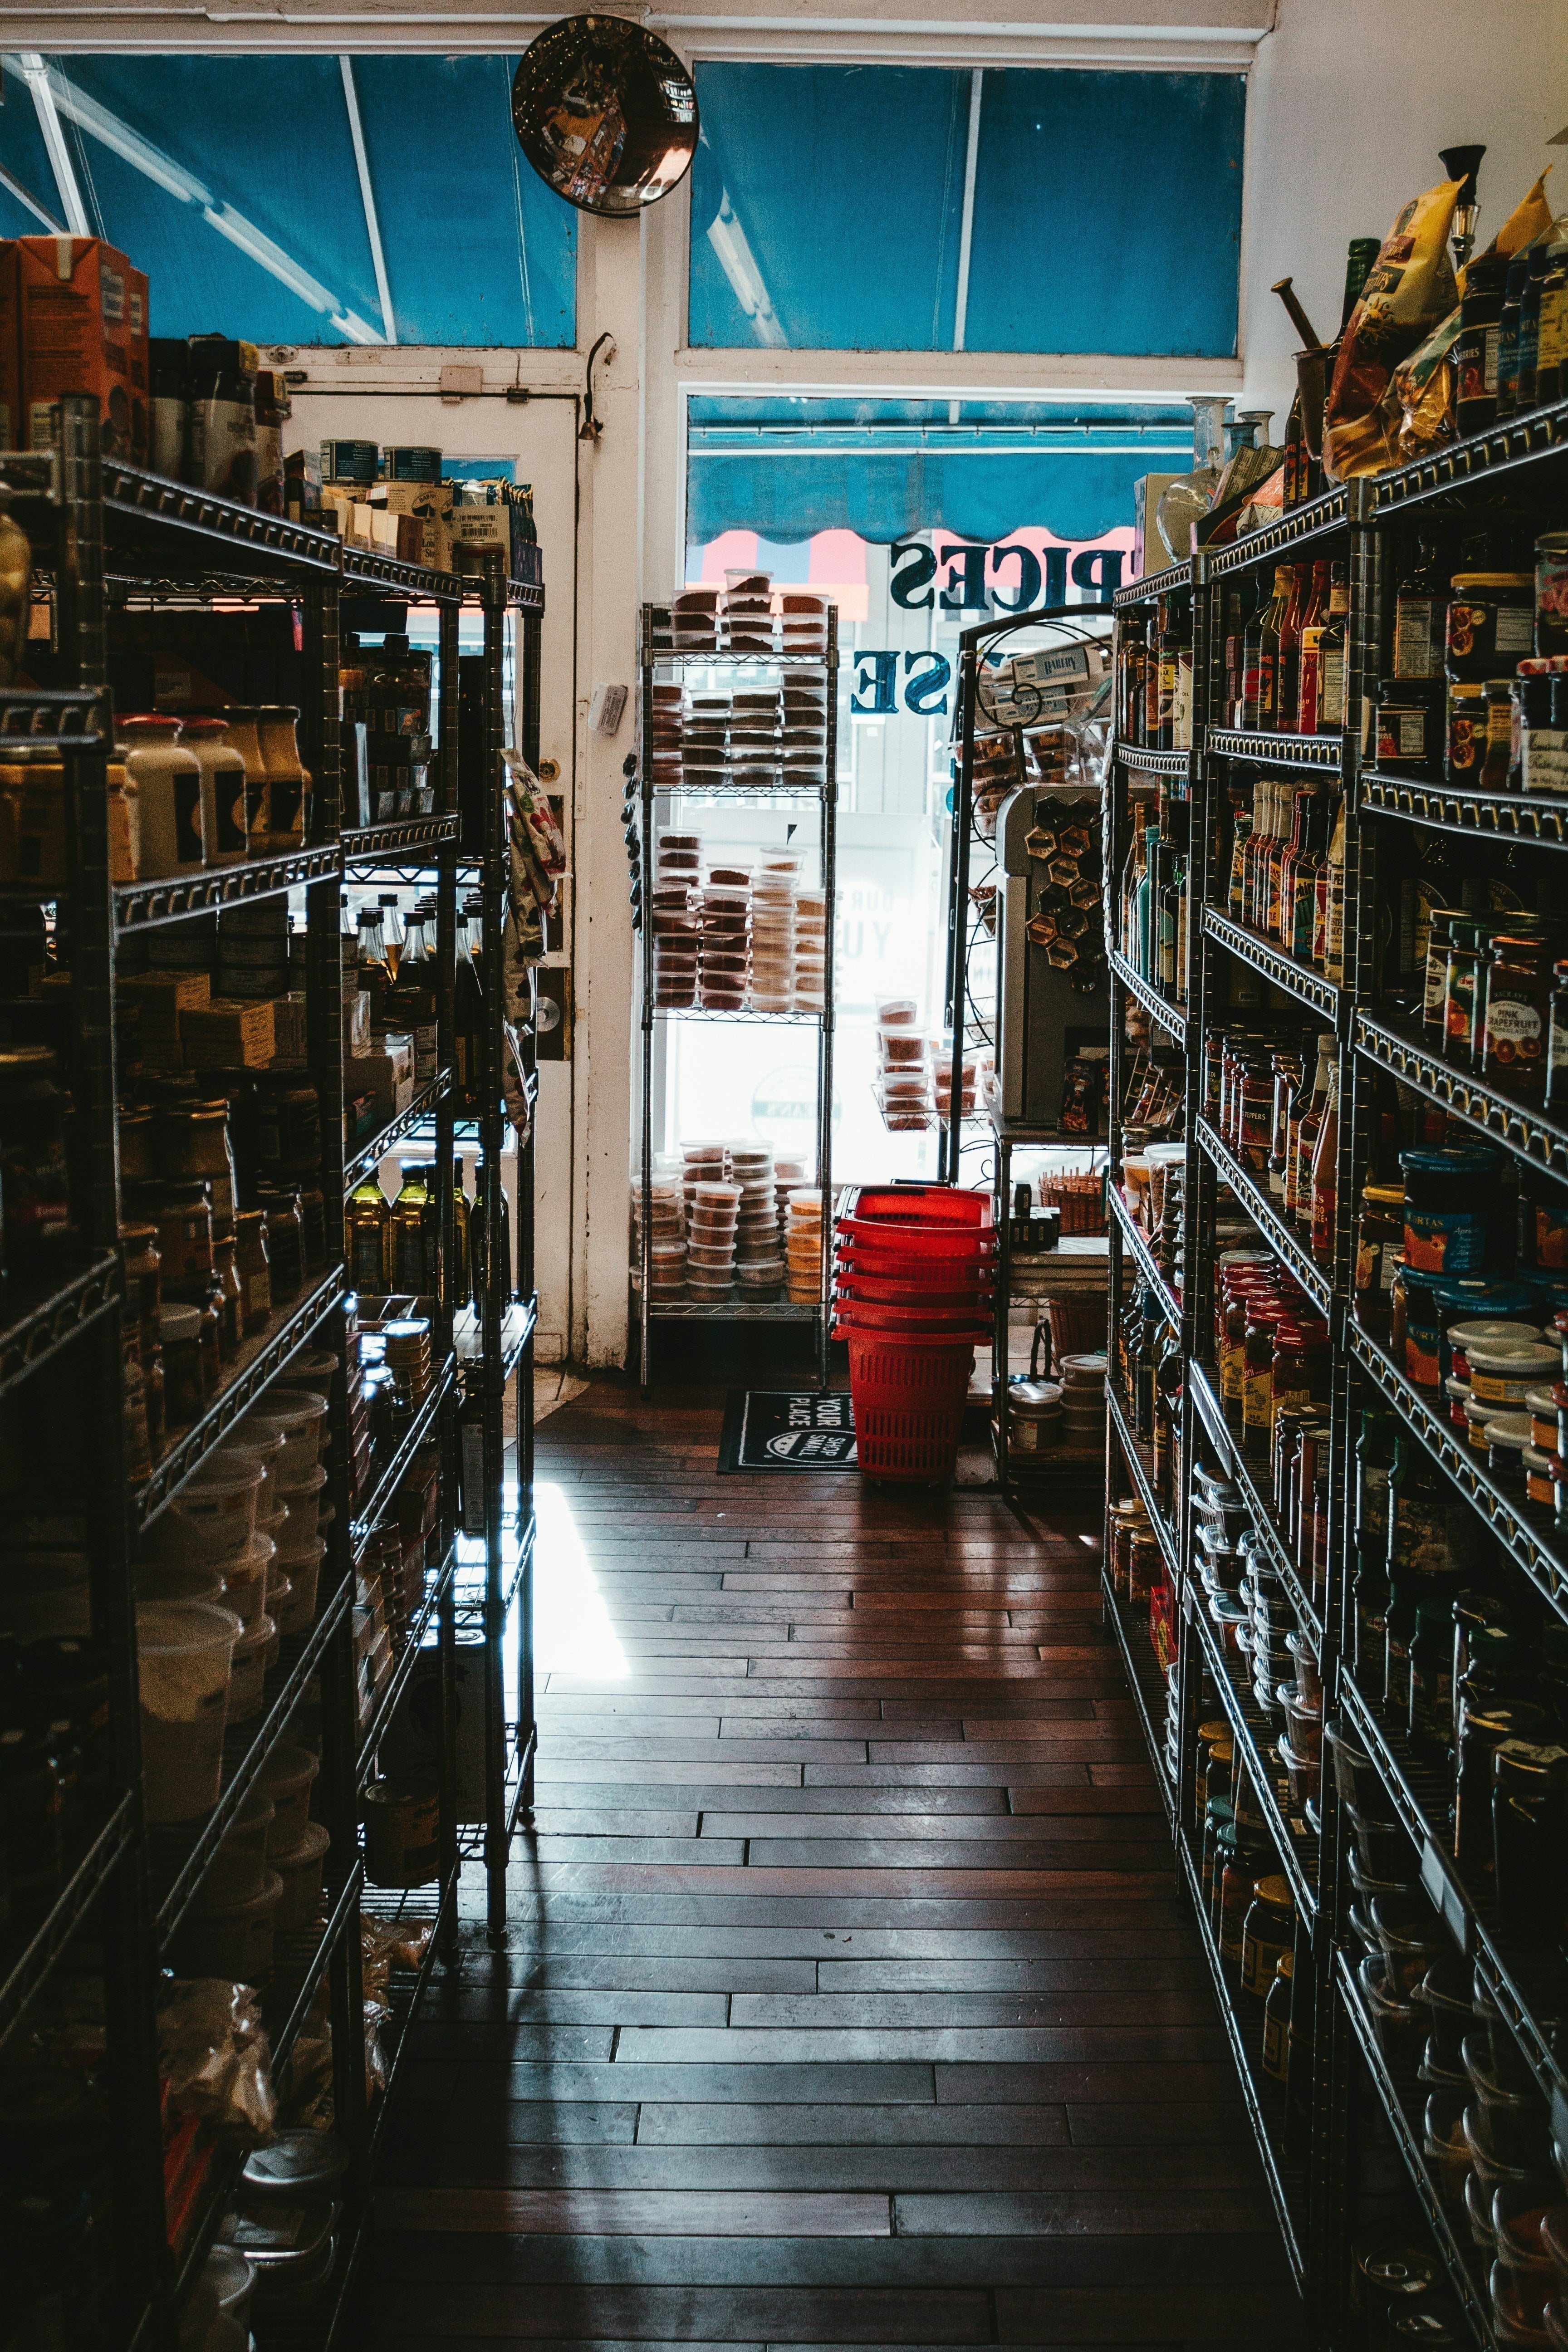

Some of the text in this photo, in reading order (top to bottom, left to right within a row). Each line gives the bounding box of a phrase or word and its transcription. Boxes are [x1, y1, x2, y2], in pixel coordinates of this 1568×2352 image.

[1489, 1018, 1538, 1029] RAPEFRUIT
[1498, 1009, 1518, 1019] PINK
[1409, 1325, 1435, 1342] CORT
[789, 1397, 811, 1426] PLACE
[816, 1398, 842, 1426] YOUR
[798, 1434, 827, 1456] SMALL
[820, 1437, 846, 1456] SHOP
